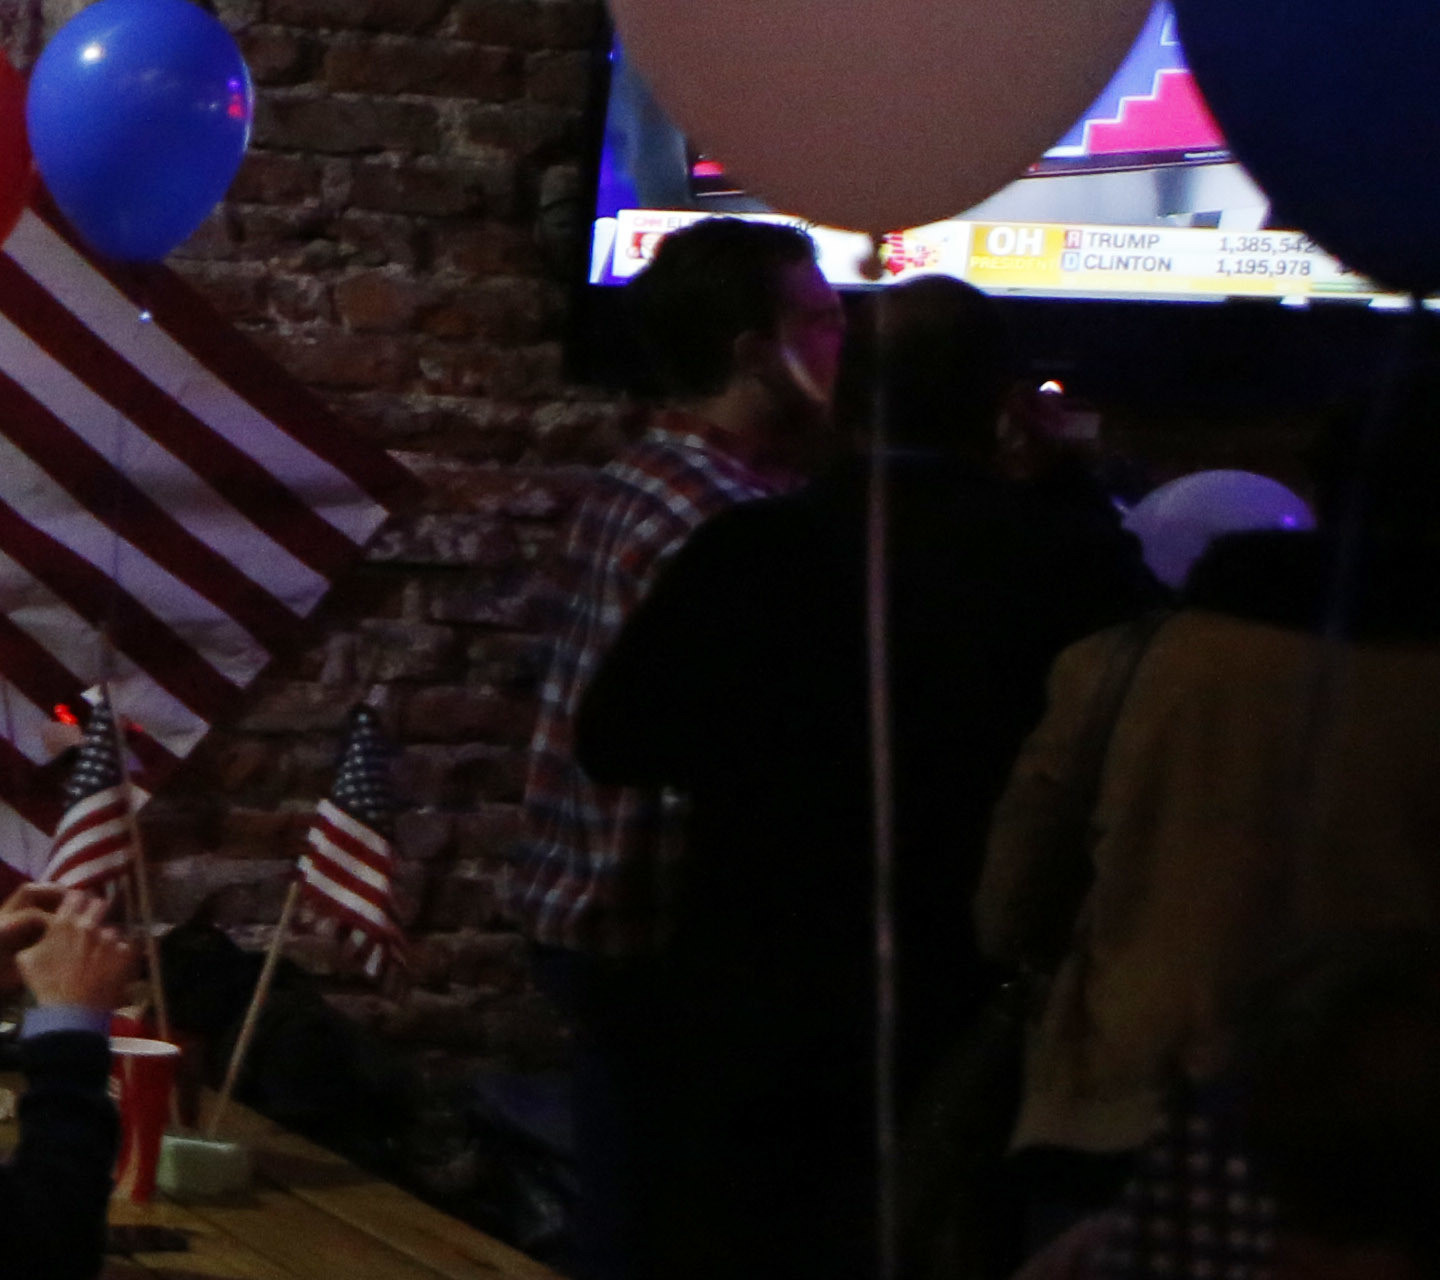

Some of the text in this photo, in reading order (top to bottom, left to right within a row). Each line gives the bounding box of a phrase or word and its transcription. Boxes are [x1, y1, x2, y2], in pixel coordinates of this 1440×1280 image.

[987, 226, 1044, 257] OH
[1087, 231, 1160, 250] TRUMP
[1219, 235, 1317, 255] 1,385,542
[1083, 253, 1172, 272] CLINTON
[1216, 258, 1312, 277] 1,195,978
